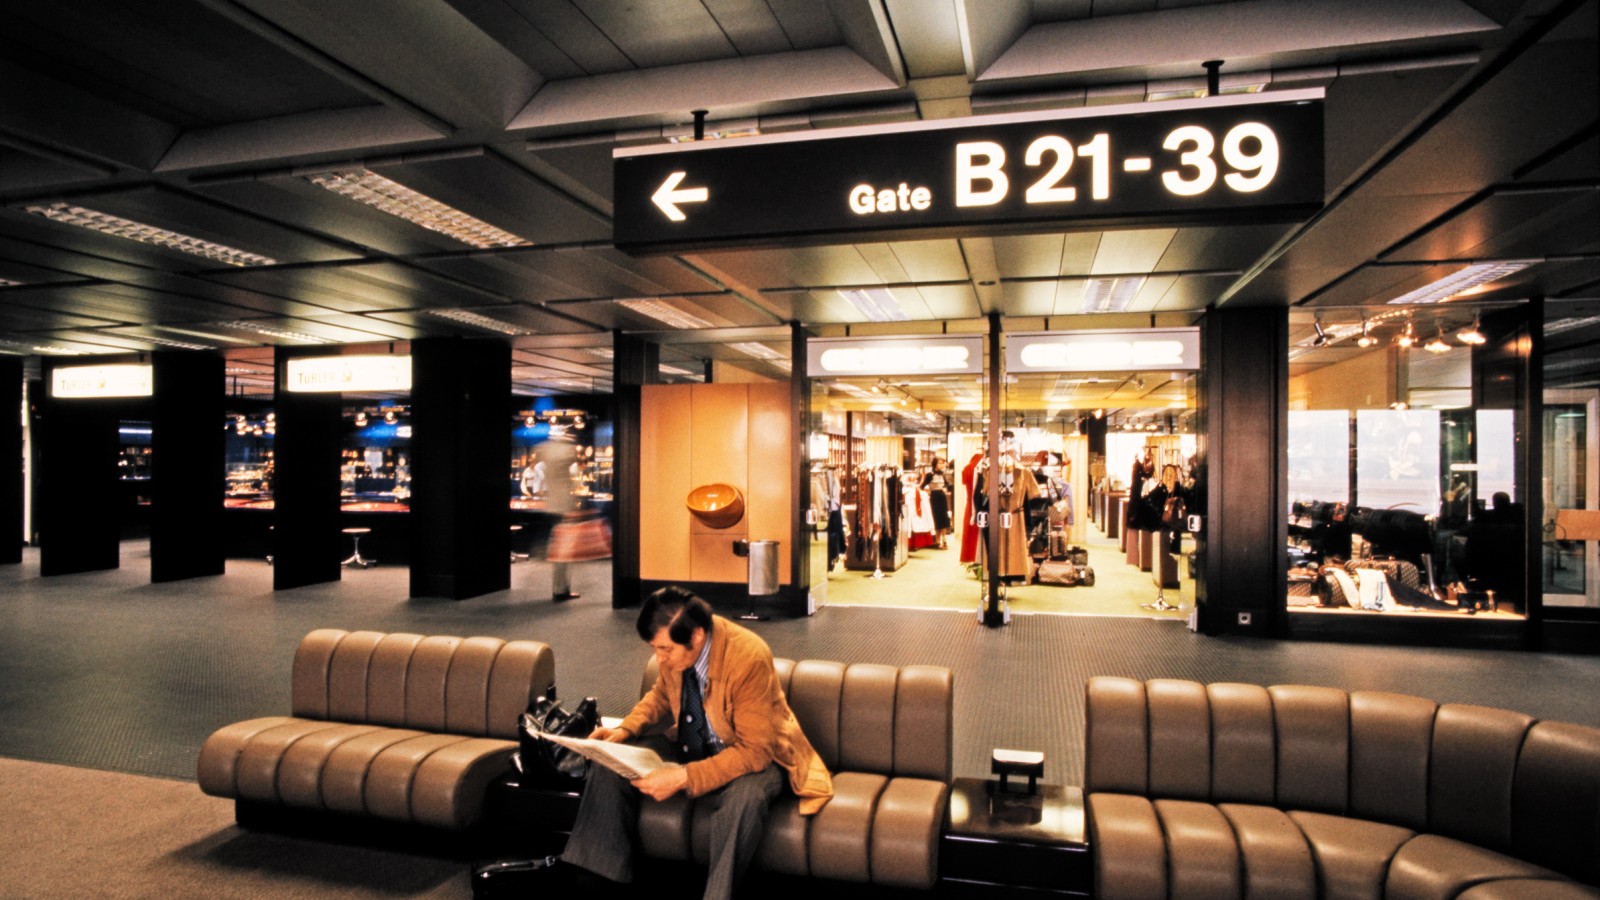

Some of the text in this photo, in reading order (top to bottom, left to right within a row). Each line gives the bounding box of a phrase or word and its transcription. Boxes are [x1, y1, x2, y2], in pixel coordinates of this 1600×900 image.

[849, 121, 1280, 214] Gate B 21-39
